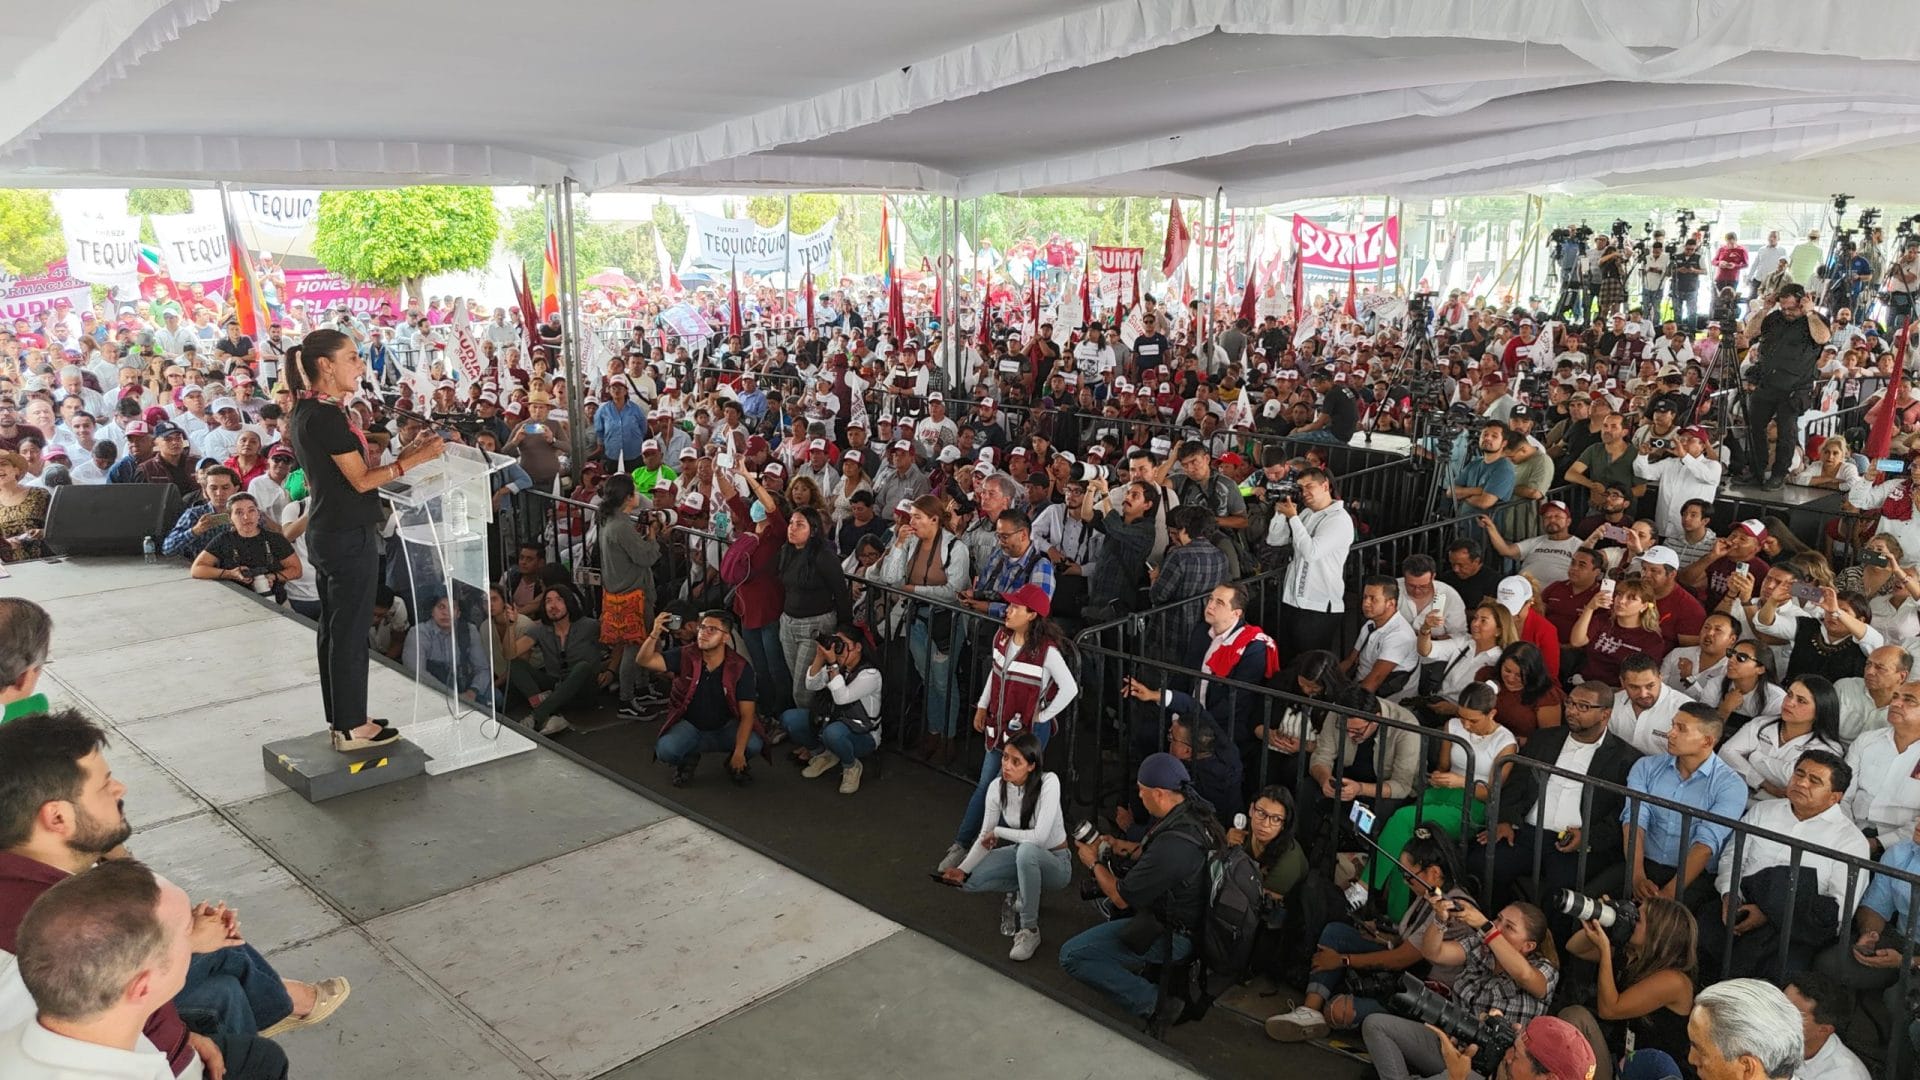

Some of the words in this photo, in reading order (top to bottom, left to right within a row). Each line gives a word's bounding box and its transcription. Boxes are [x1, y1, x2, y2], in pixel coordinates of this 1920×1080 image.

[249, 190, 313, 221] TEQUIO
[704, 232, 752, 257] TEQUIO
[1297, 222, 1397, 265] SUMA
[1097, 250, 1142, 269] SUMA
